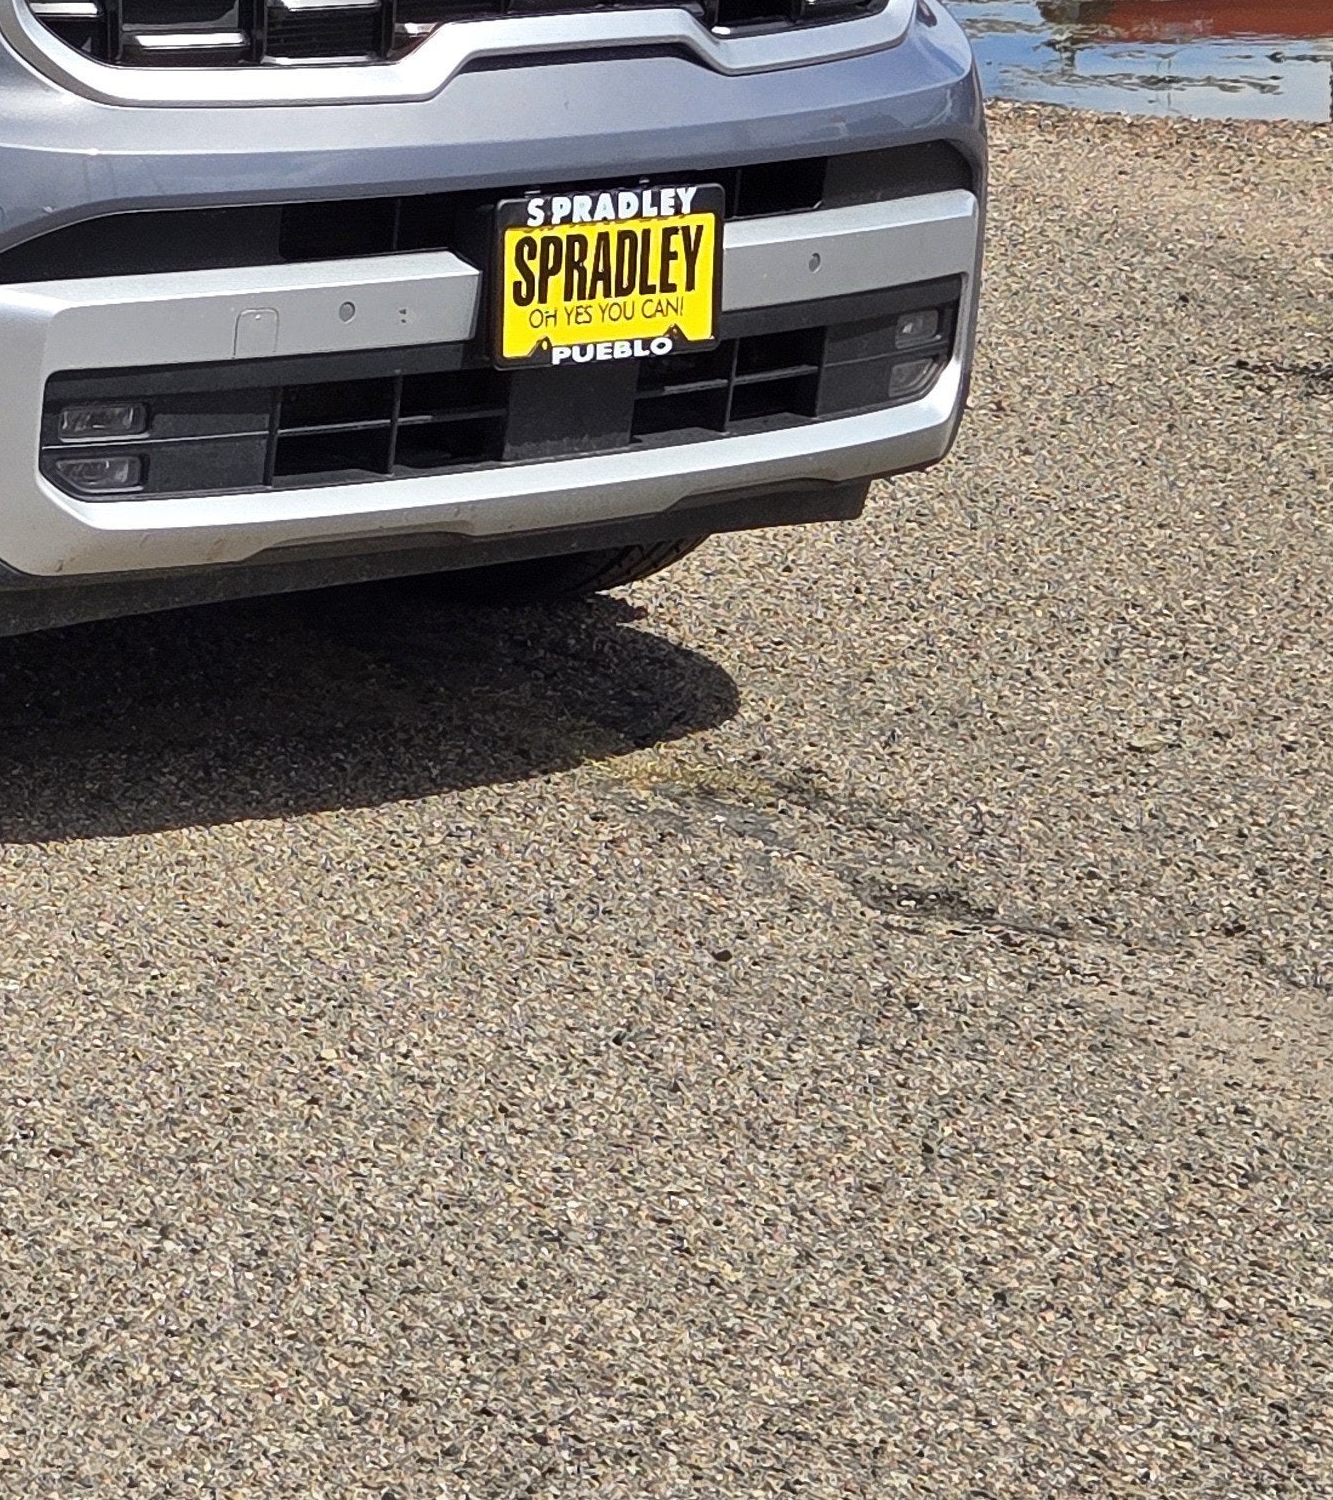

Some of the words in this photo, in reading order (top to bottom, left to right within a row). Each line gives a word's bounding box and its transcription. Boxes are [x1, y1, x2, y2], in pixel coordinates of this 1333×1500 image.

[512, 224, 704, 306] SPRADLEY
[529, 308, 557, 328] OH
[564, 305, 592, 326] YES
[599, 300, 635, 323] YOU
[641, 297, 684, 318] CAN!
[552, 336, 673, 366] PUEBLO
